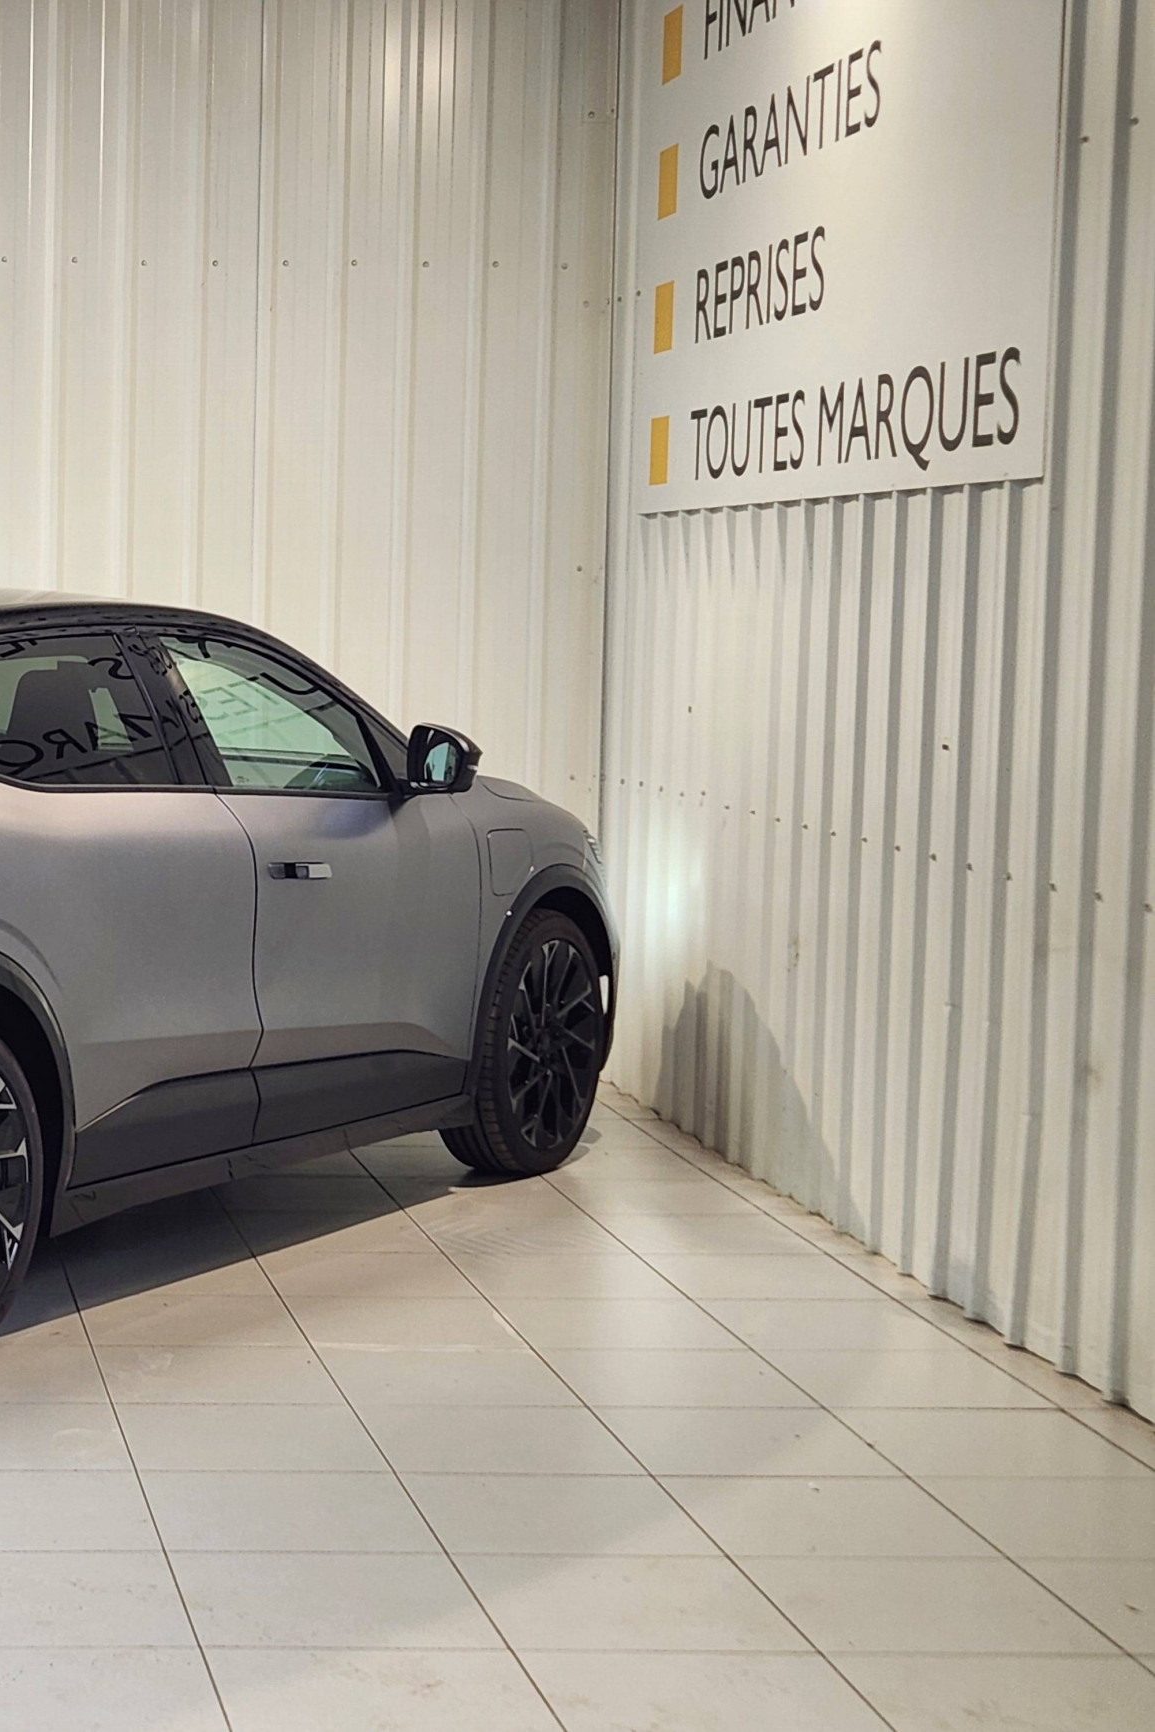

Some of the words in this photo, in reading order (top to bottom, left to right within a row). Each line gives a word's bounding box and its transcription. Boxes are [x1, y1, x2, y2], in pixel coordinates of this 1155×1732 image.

[703, 0, 795, 60] FIN
[699, 40, 882, 200] GARANTIES
[694, 225, 825, 344] REPRISES
[691, 390, 804, 480] TOUTES
[818, 347, 1020, 470] MARQUES
